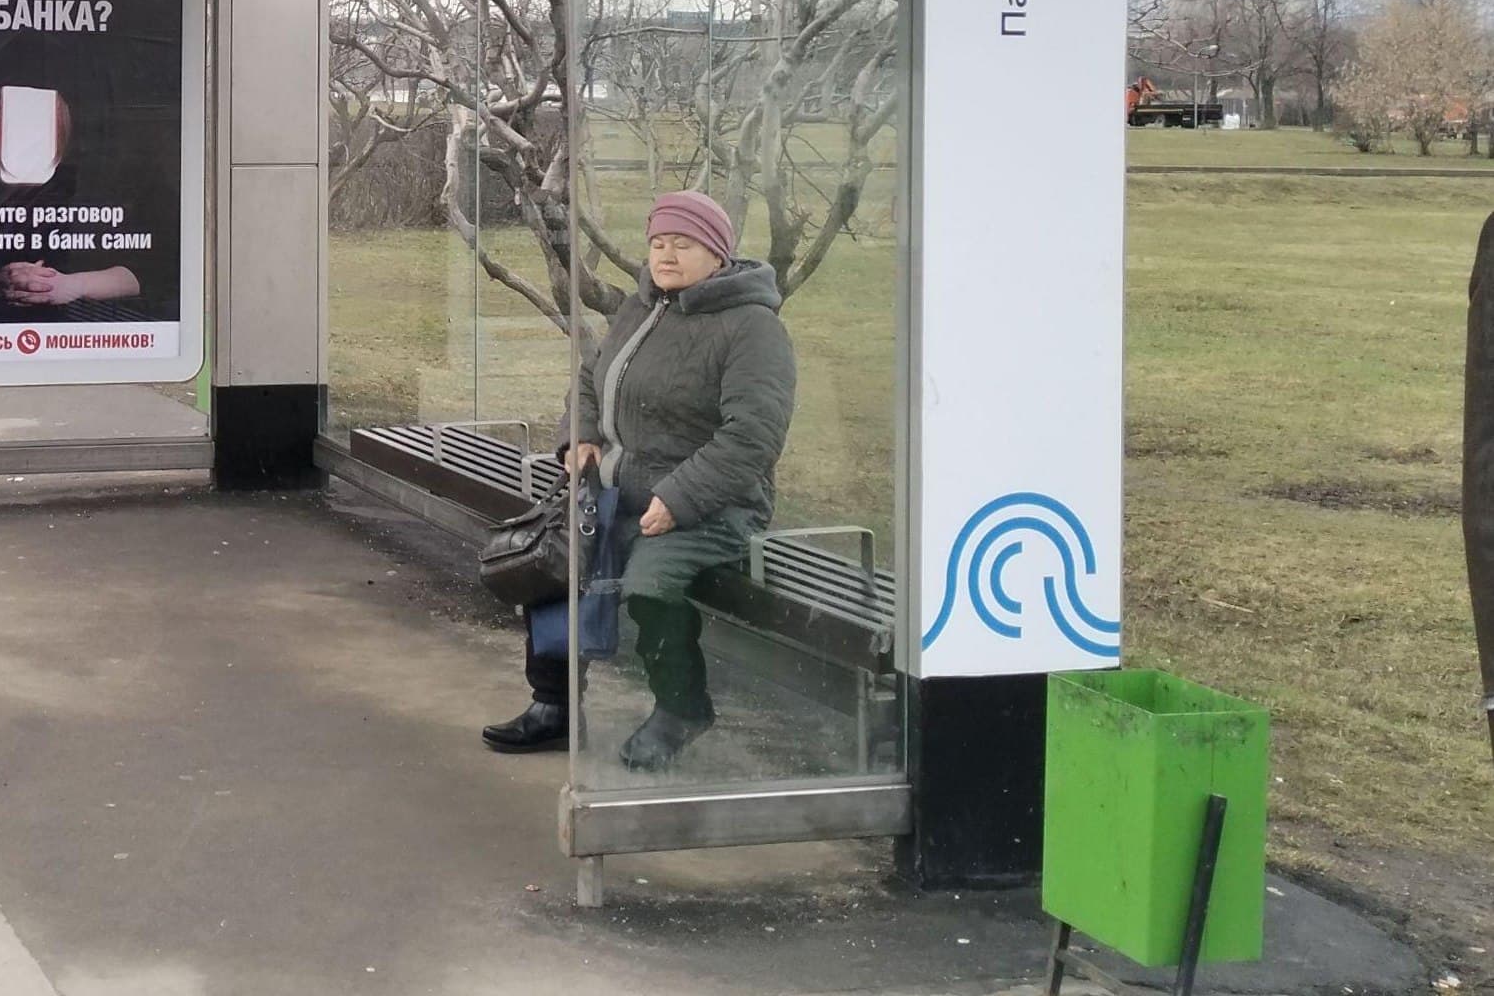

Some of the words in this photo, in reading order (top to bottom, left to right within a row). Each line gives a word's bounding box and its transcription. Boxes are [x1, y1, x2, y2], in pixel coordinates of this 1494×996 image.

[32, 206, 125, 227] разговор
[31, 233, 43, 250] в
[48, 229, 96, 250] банк
[101, 233, 152, 250] сами
[45, 334, 154, 349] МОШЕННИКОВ!
